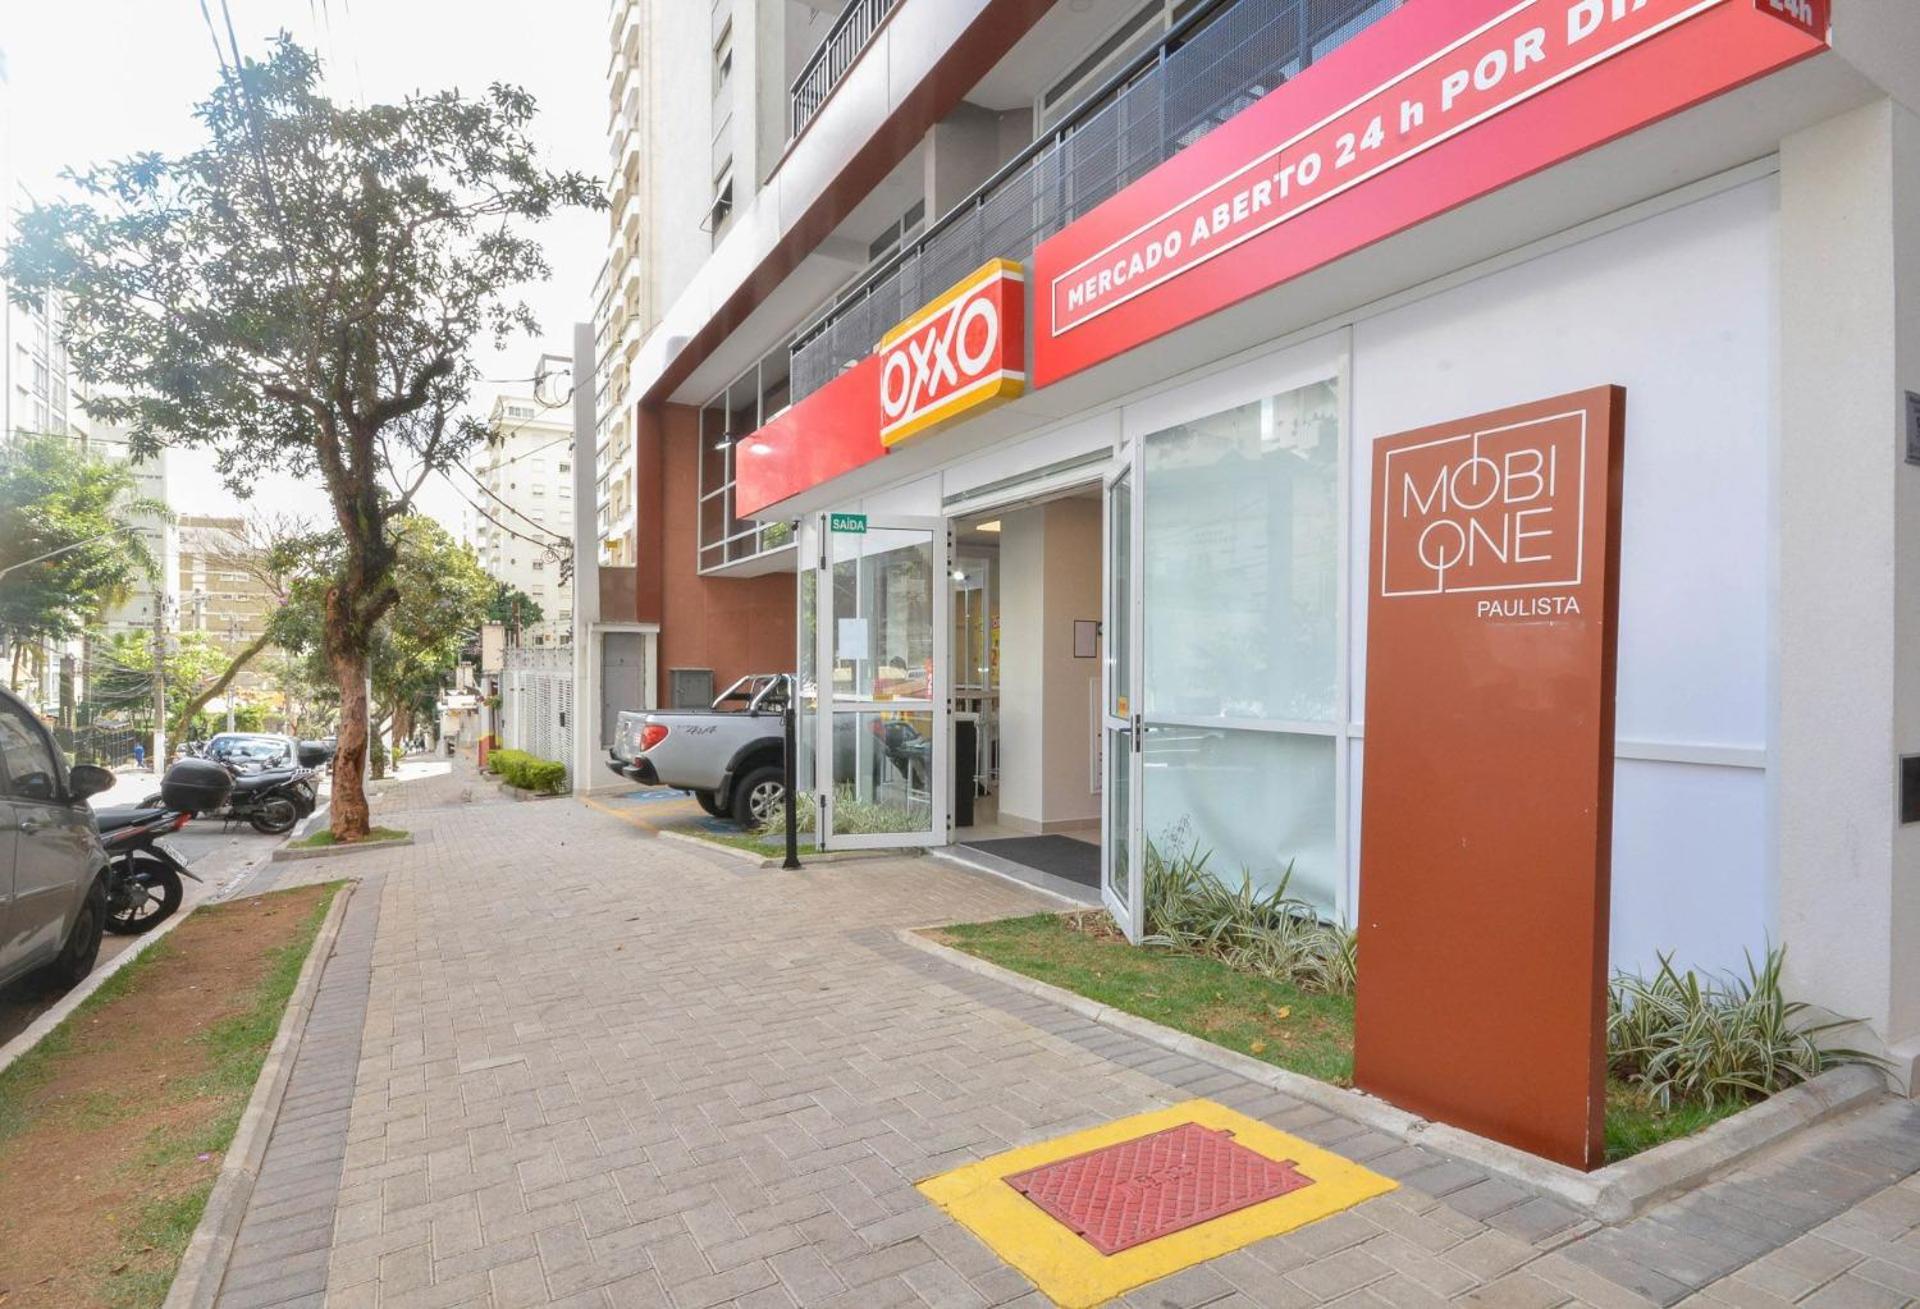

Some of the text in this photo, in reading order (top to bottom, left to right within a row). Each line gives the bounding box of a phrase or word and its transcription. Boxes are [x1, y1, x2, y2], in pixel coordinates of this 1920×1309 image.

[1067, 230, 1183, 311] MERCADO
[1190, 152, 1322, 247] ABERTO
[1334, 115, 1385, 170] 24
[1400, 100, 1424, 134] h
[1441, 26, 1546, 112] POR
[882, 296, 999, 418] OXXO
[1402, 444, 1556, 518] MOBI
[832, 516, 865, 532] SAÍDA
[1418, 506, 1553, 570] ONE
[1477, 595, 1581, 618] PAULISTA
